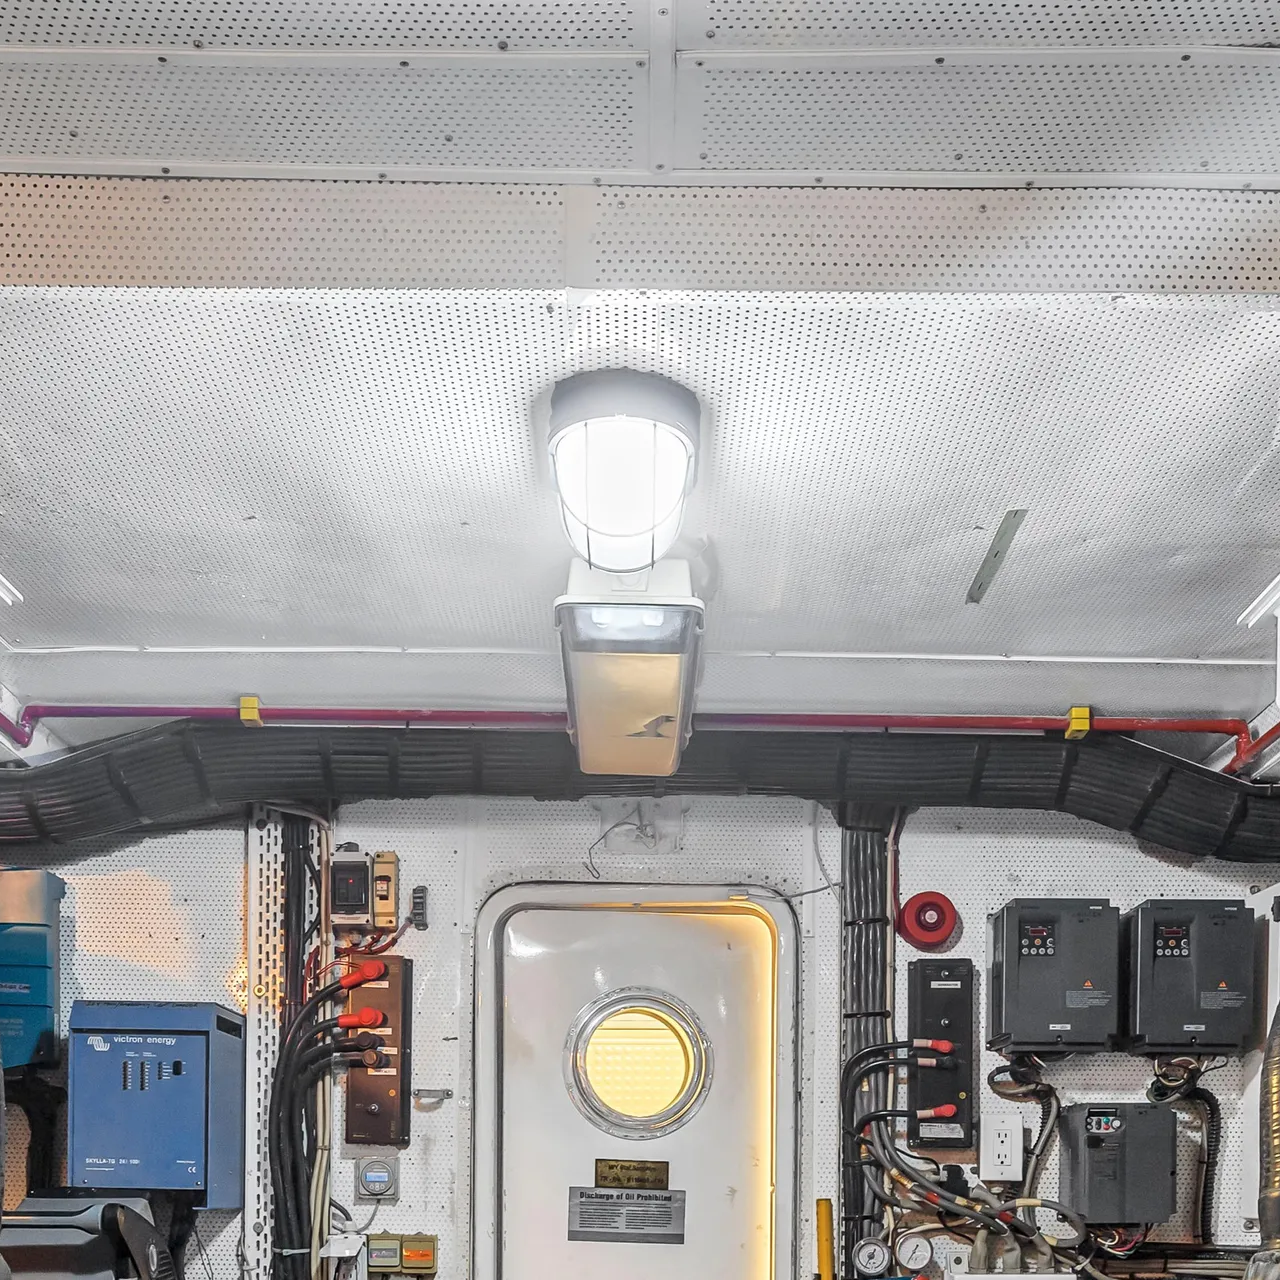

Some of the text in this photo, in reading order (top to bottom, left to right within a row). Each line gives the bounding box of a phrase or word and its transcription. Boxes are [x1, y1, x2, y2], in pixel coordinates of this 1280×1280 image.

[113, 1035, 177, 1046] victron energy
[579, 1191, 614, 1201] Discharge
[616, 1192, 624, 1200] of
[636, 1193, 672, 1202] Prohibited
